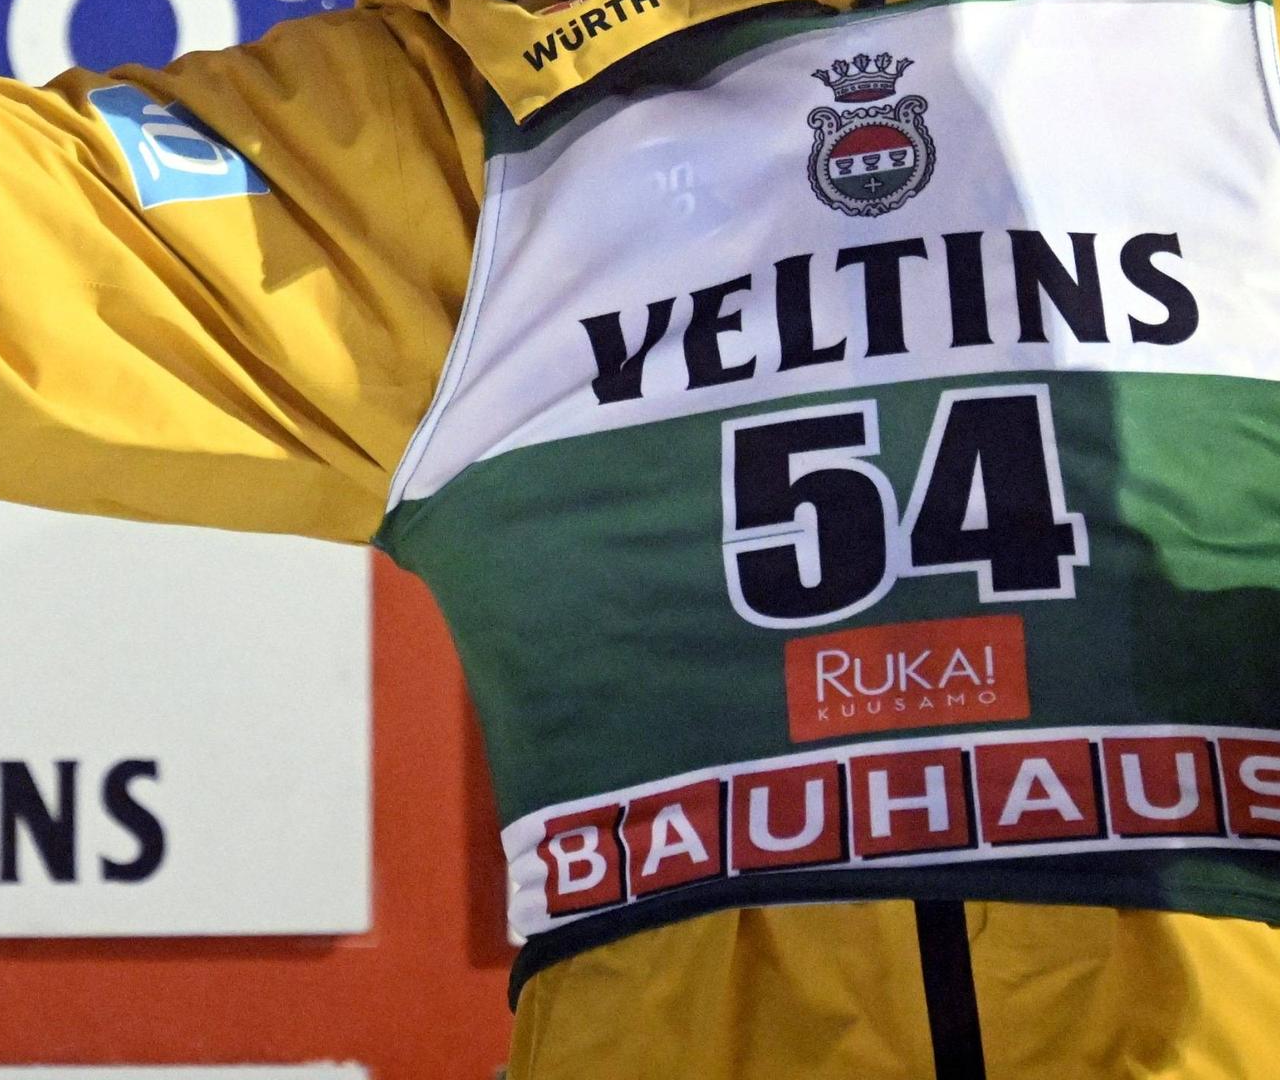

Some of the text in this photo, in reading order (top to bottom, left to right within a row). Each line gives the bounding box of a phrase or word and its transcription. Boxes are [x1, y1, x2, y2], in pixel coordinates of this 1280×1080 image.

[578, 230, 1201, 406] VELTINS
[721, 382, 1091, 630] 54
[817, 645, 995, 702] RUKA!
[818, 690, 996, 721] KUUSAMO
